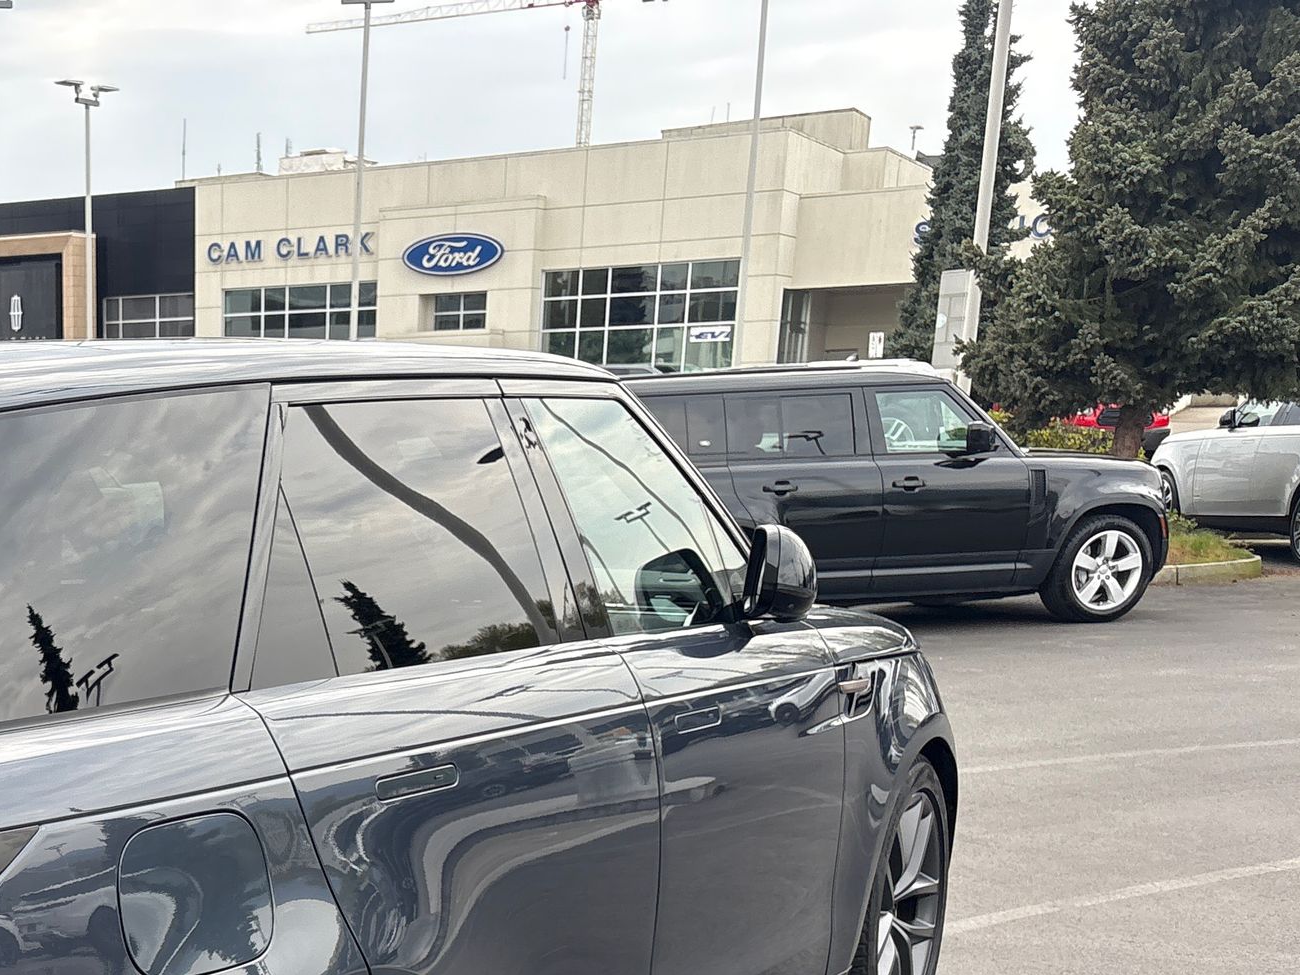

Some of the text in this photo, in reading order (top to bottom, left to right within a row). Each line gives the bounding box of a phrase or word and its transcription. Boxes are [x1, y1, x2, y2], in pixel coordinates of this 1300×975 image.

[207, 231, 375, 264] CAM CLARK
[422, 240, 482, 269] Ford
